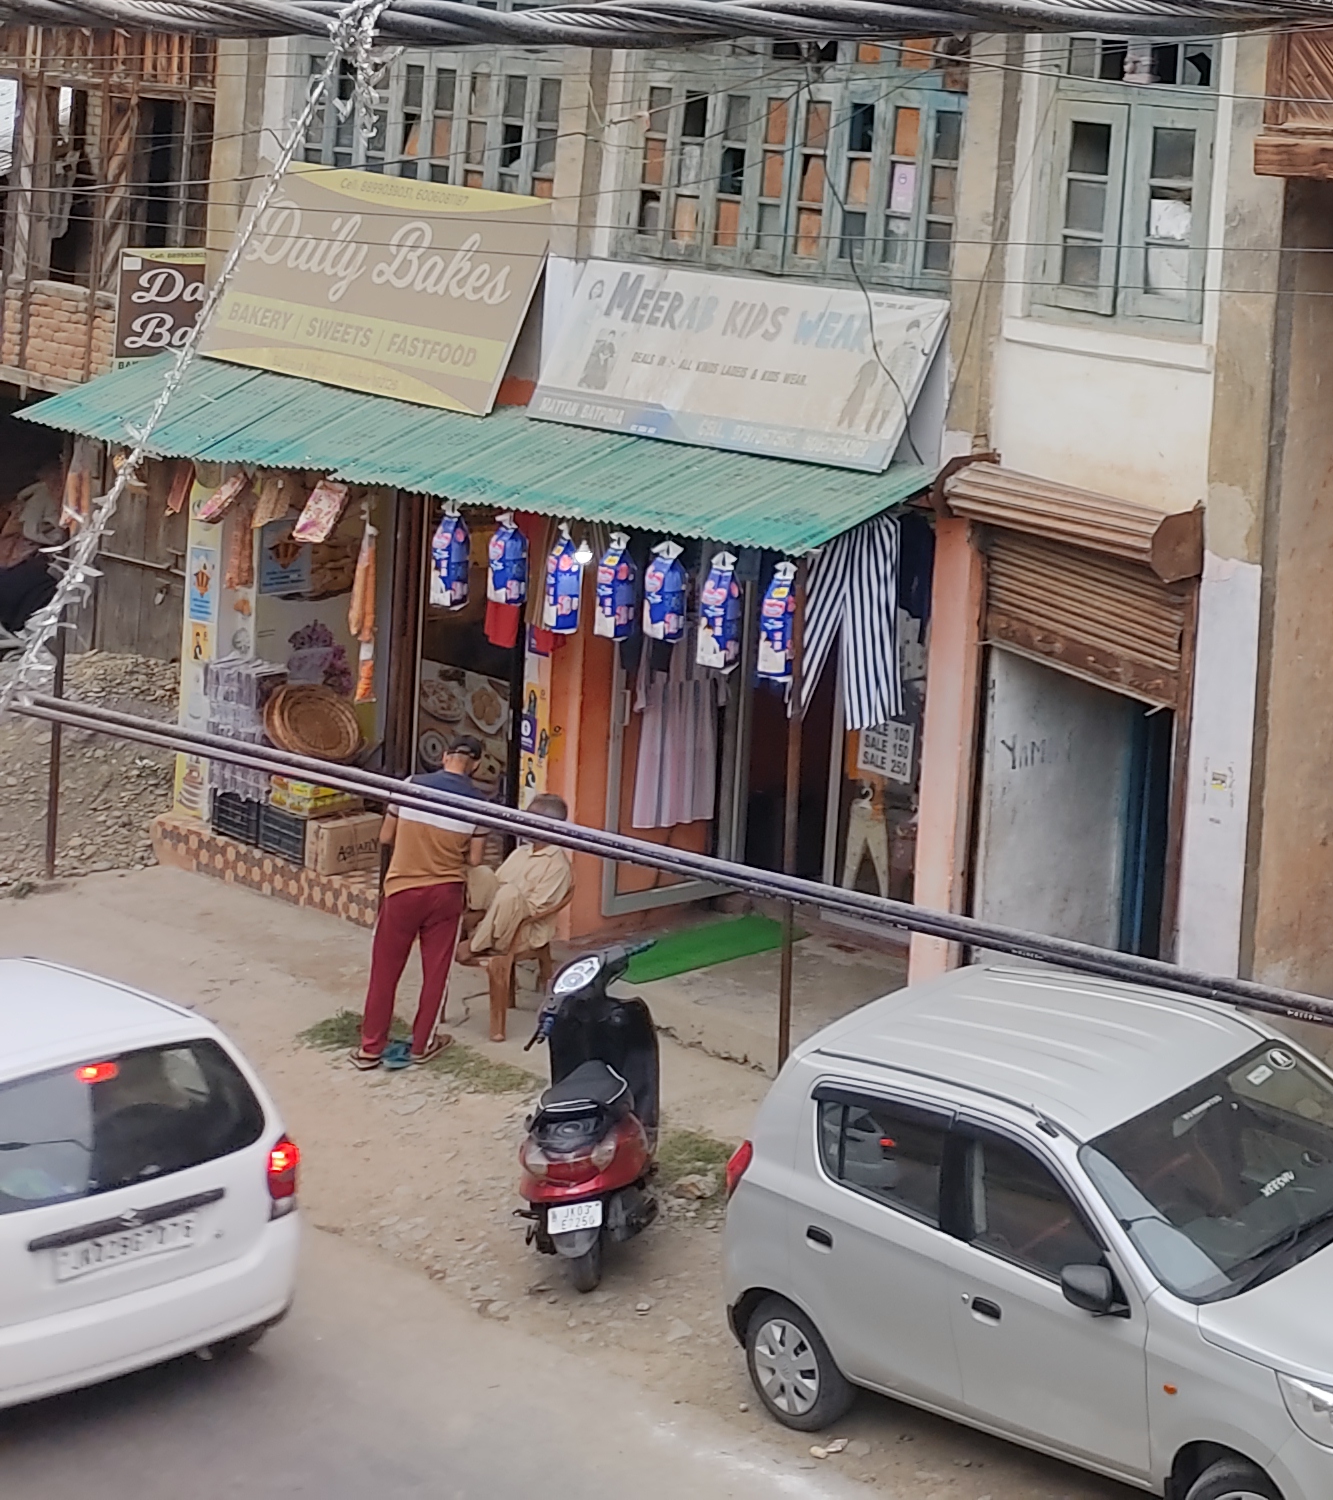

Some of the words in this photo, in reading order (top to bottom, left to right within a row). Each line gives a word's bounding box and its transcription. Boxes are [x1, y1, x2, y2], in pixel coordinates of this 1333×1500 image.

[245, 199, 369, 302] Daily
[371, 221, 513, 306] Bakes
[228, 301, 294, 331] BAKERY
[306, 317, 374, 348] SWEETS
[387, 333, 478, 369] FASTFOOD
[604, 272, 720, 334] MEERAB
[722, 299, 790, 342] KIDS
[793, 309, 870, 355] WEAR
[862, 751, 887, 771] SALE
[890, 759, 908, 777] 250
[864, 734, 889, 754] SALE
[892, 743, 909, 760] 150
